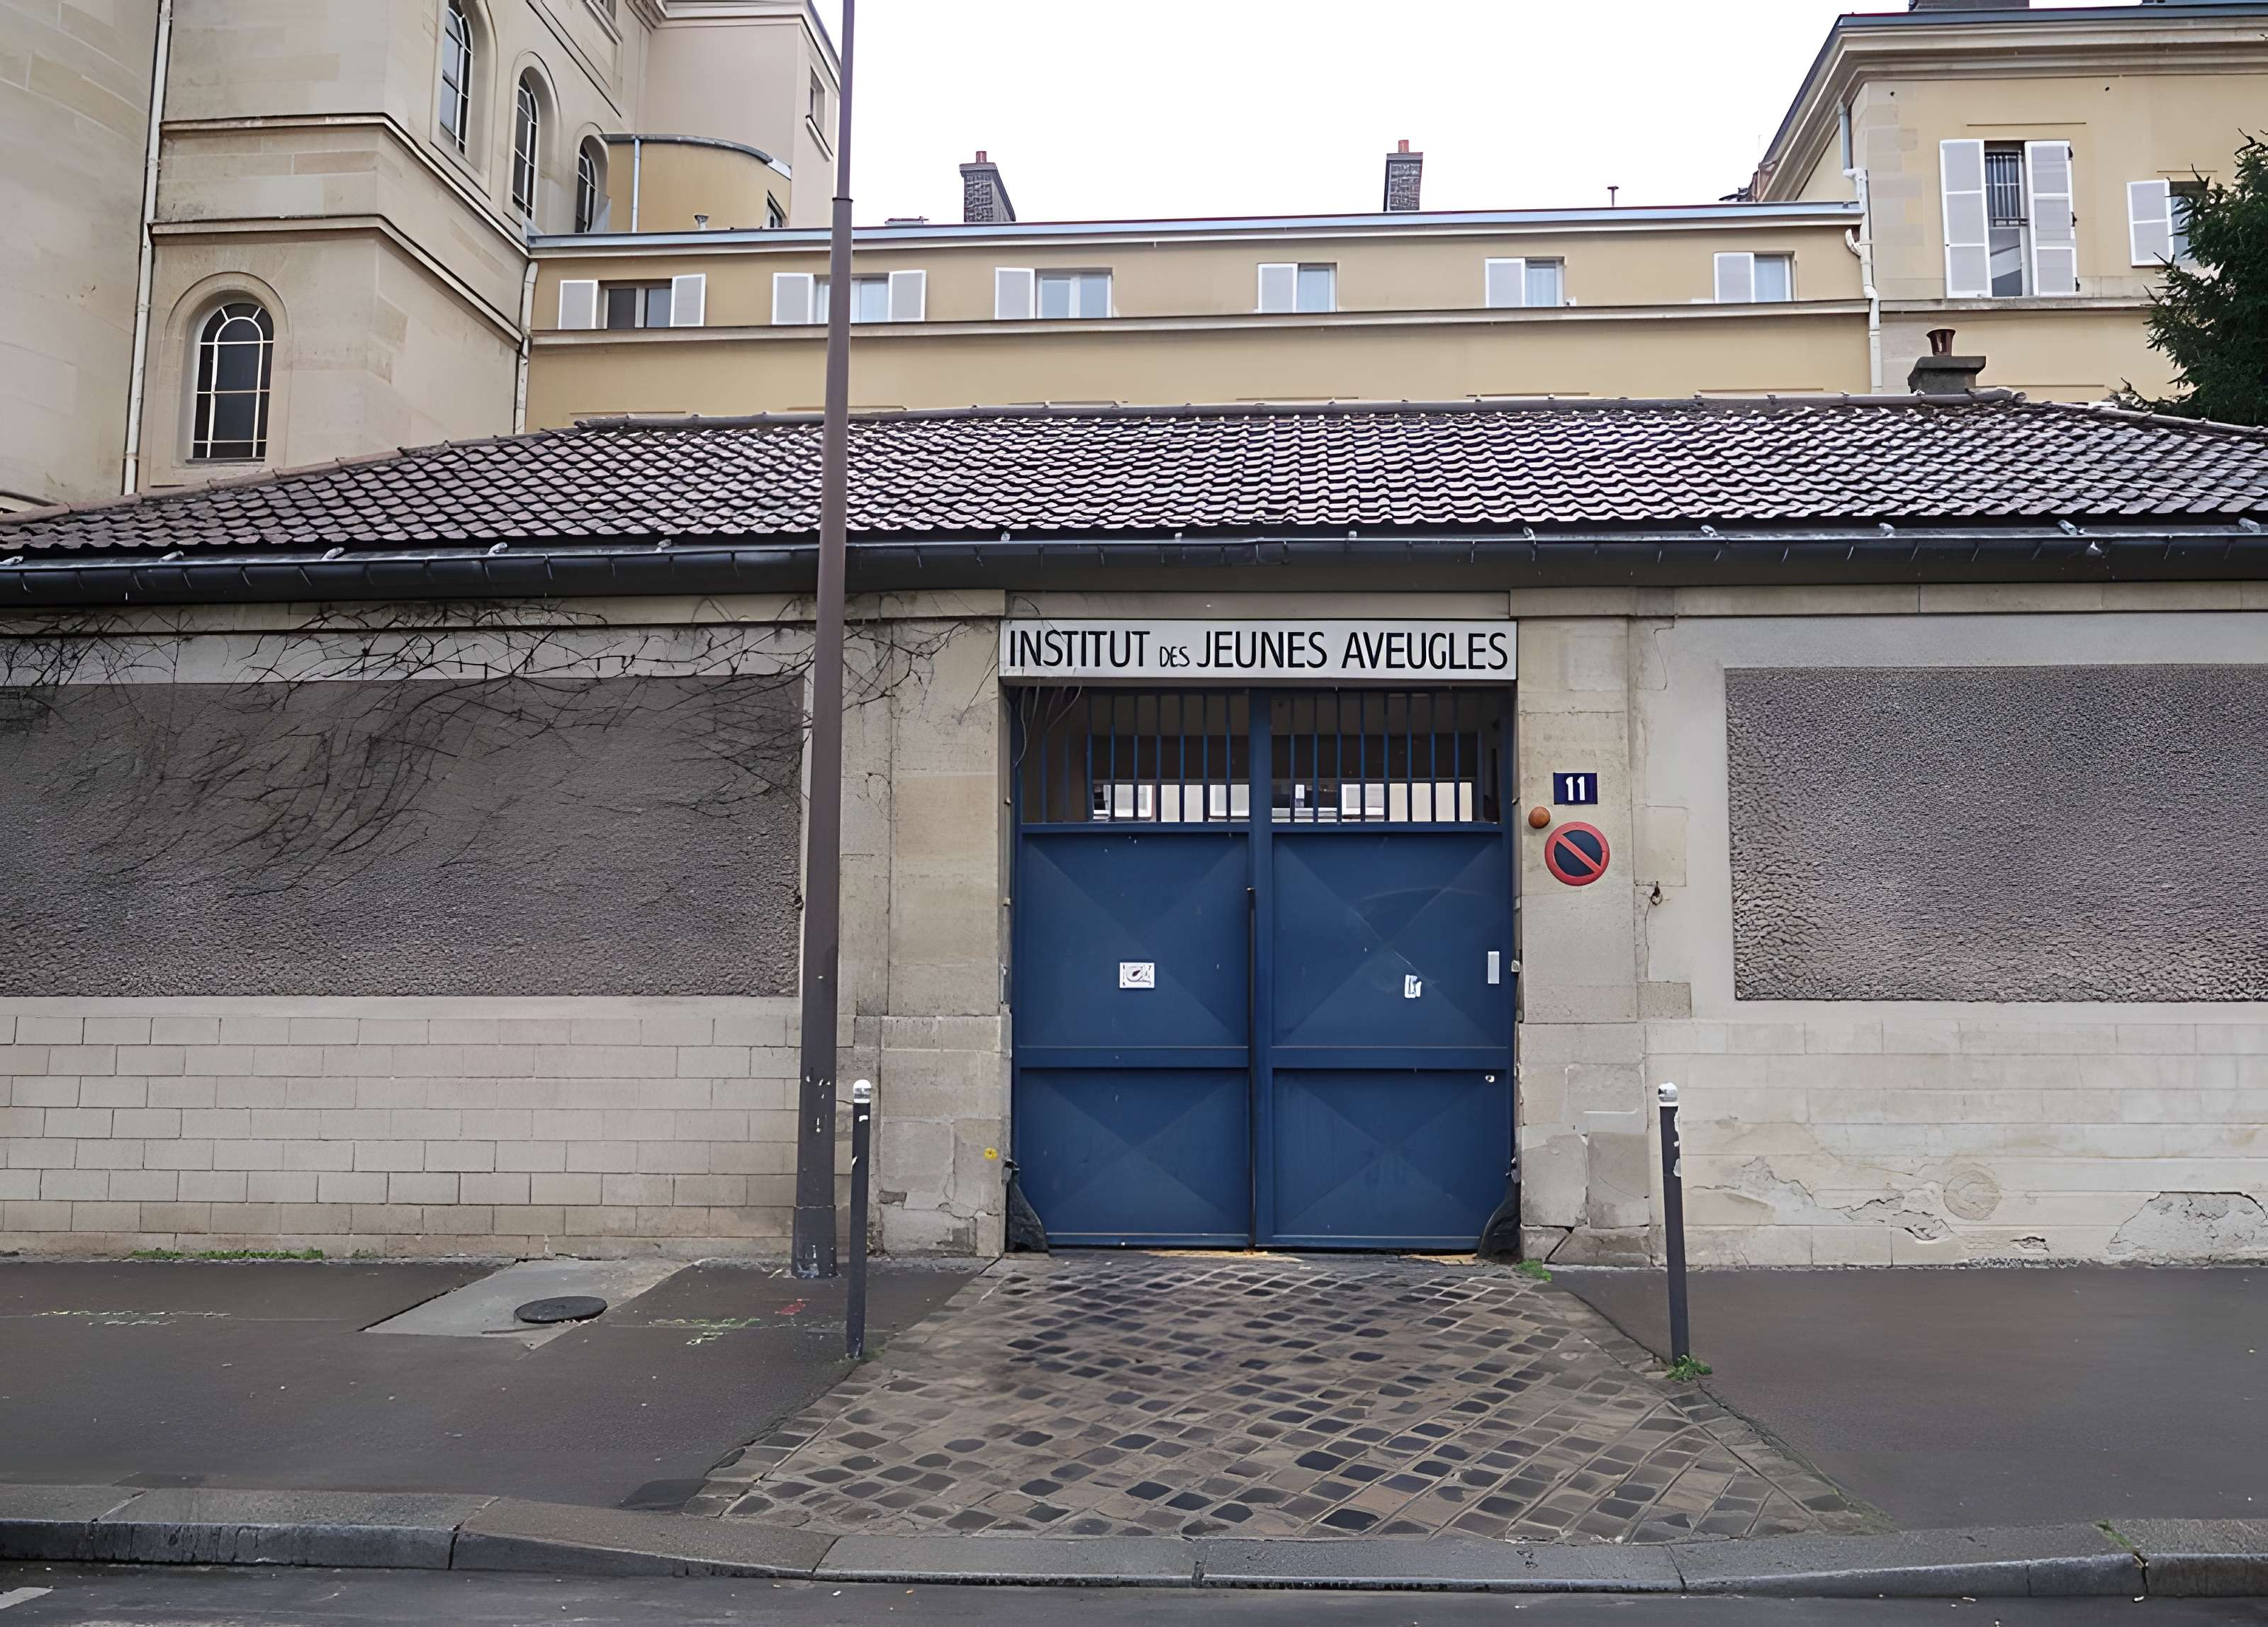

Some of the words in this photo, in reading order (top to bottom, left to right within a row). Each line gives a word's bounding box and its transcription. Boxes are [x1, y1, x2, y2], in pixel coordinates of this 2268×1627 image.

[1009, 629, 1150, 668] INSTITUT
[1159, 646, 1190, 668] DES
[1196, 631, 1327, 668] JEUNES
[1340, 631, 1508, 670] AVEUGLES
[1566, 777, 1585, 801] 11
